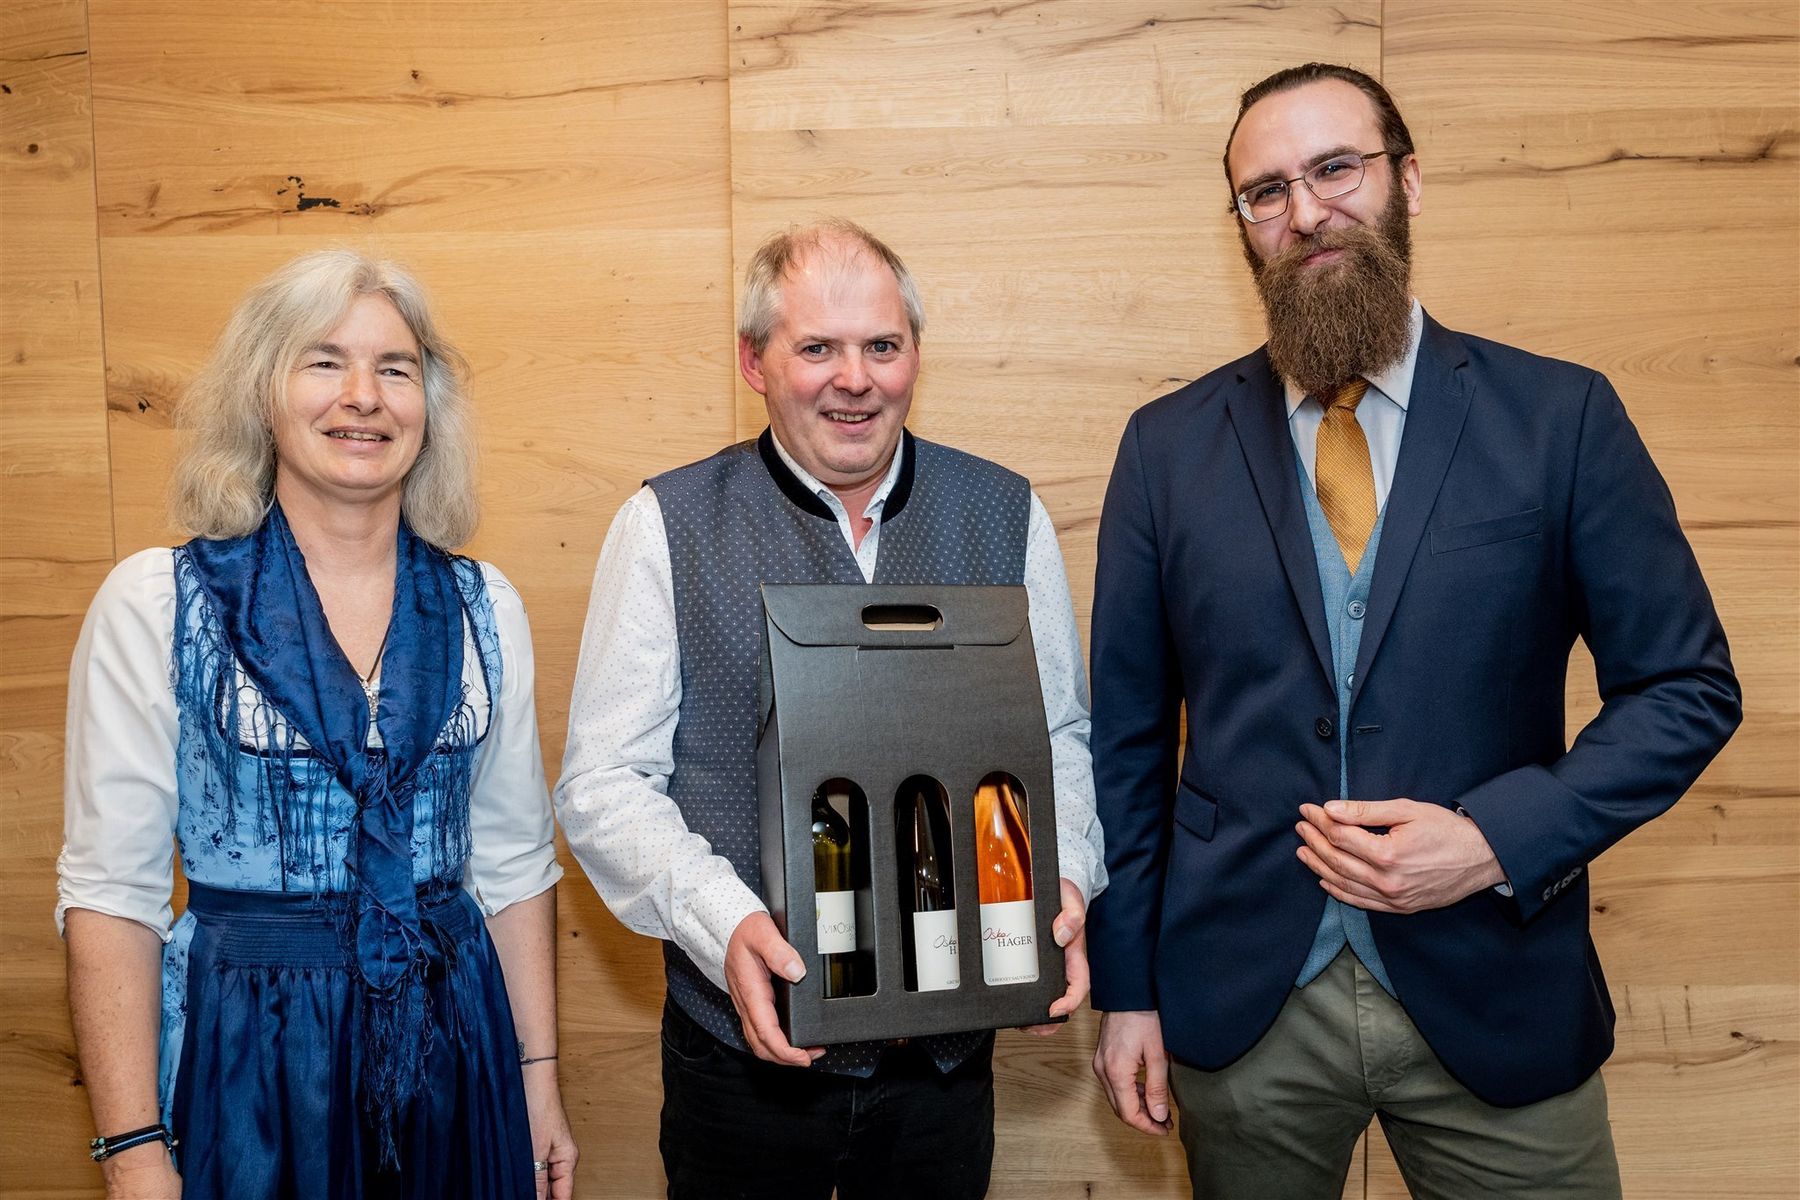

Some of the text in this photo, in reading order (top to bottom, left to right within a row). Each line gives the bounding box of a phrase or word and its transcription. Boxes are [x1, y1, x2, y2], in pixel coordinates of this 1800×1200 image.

[983, 927, 1012, 941] Oskar
[933, 934, 957, 949] Oska
[997, 935, 1033, 948] HAGER
[949, 945, 957, 955] H
